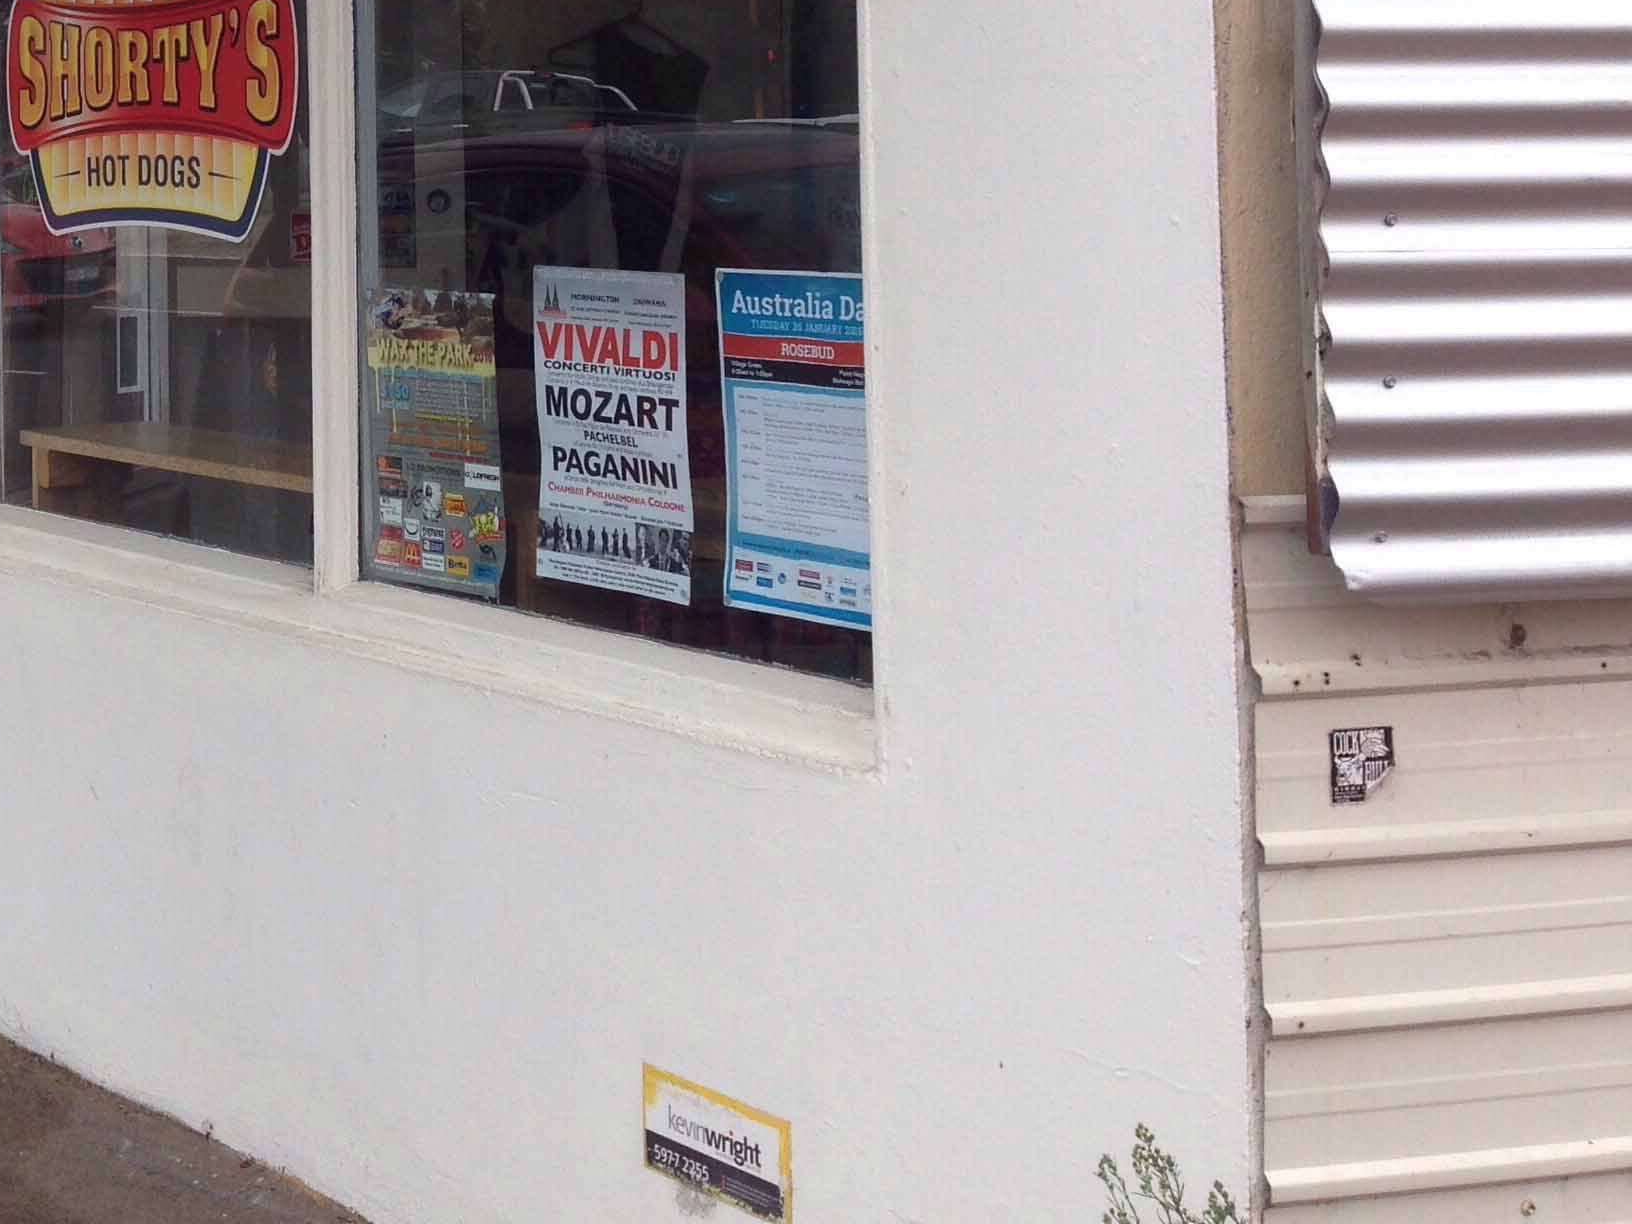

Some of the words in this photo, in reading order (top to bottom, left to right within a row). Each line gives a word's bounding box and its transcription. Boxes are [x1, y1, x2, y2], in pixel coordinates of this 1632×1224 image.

[86, 155, 129, 188] HOT
[138, 154, 201, 189] DOGS
[731, 289, 833, 319] Australia
[376, 336, 409, 363] WAX
[536, 320, 679, 372] VIVALDI
[780, 343, 835, 360] ROSEBUD
[543, 359, 610, 375] CONCERTI
[613, 366, 676, 382] VIRTUOSI
[544, 383, 680, 432] MOZART
[584, 429, 639, 448] PACHELBEL
[552, 445, 679, 490] PAGANINI
[1333, 731, 1359, 755] COCK
[667, 1103, 762, 1168] kevinwright
[653, 1143, 680, 1168] 5977
[682, 1156, 710, 1182] 2255
